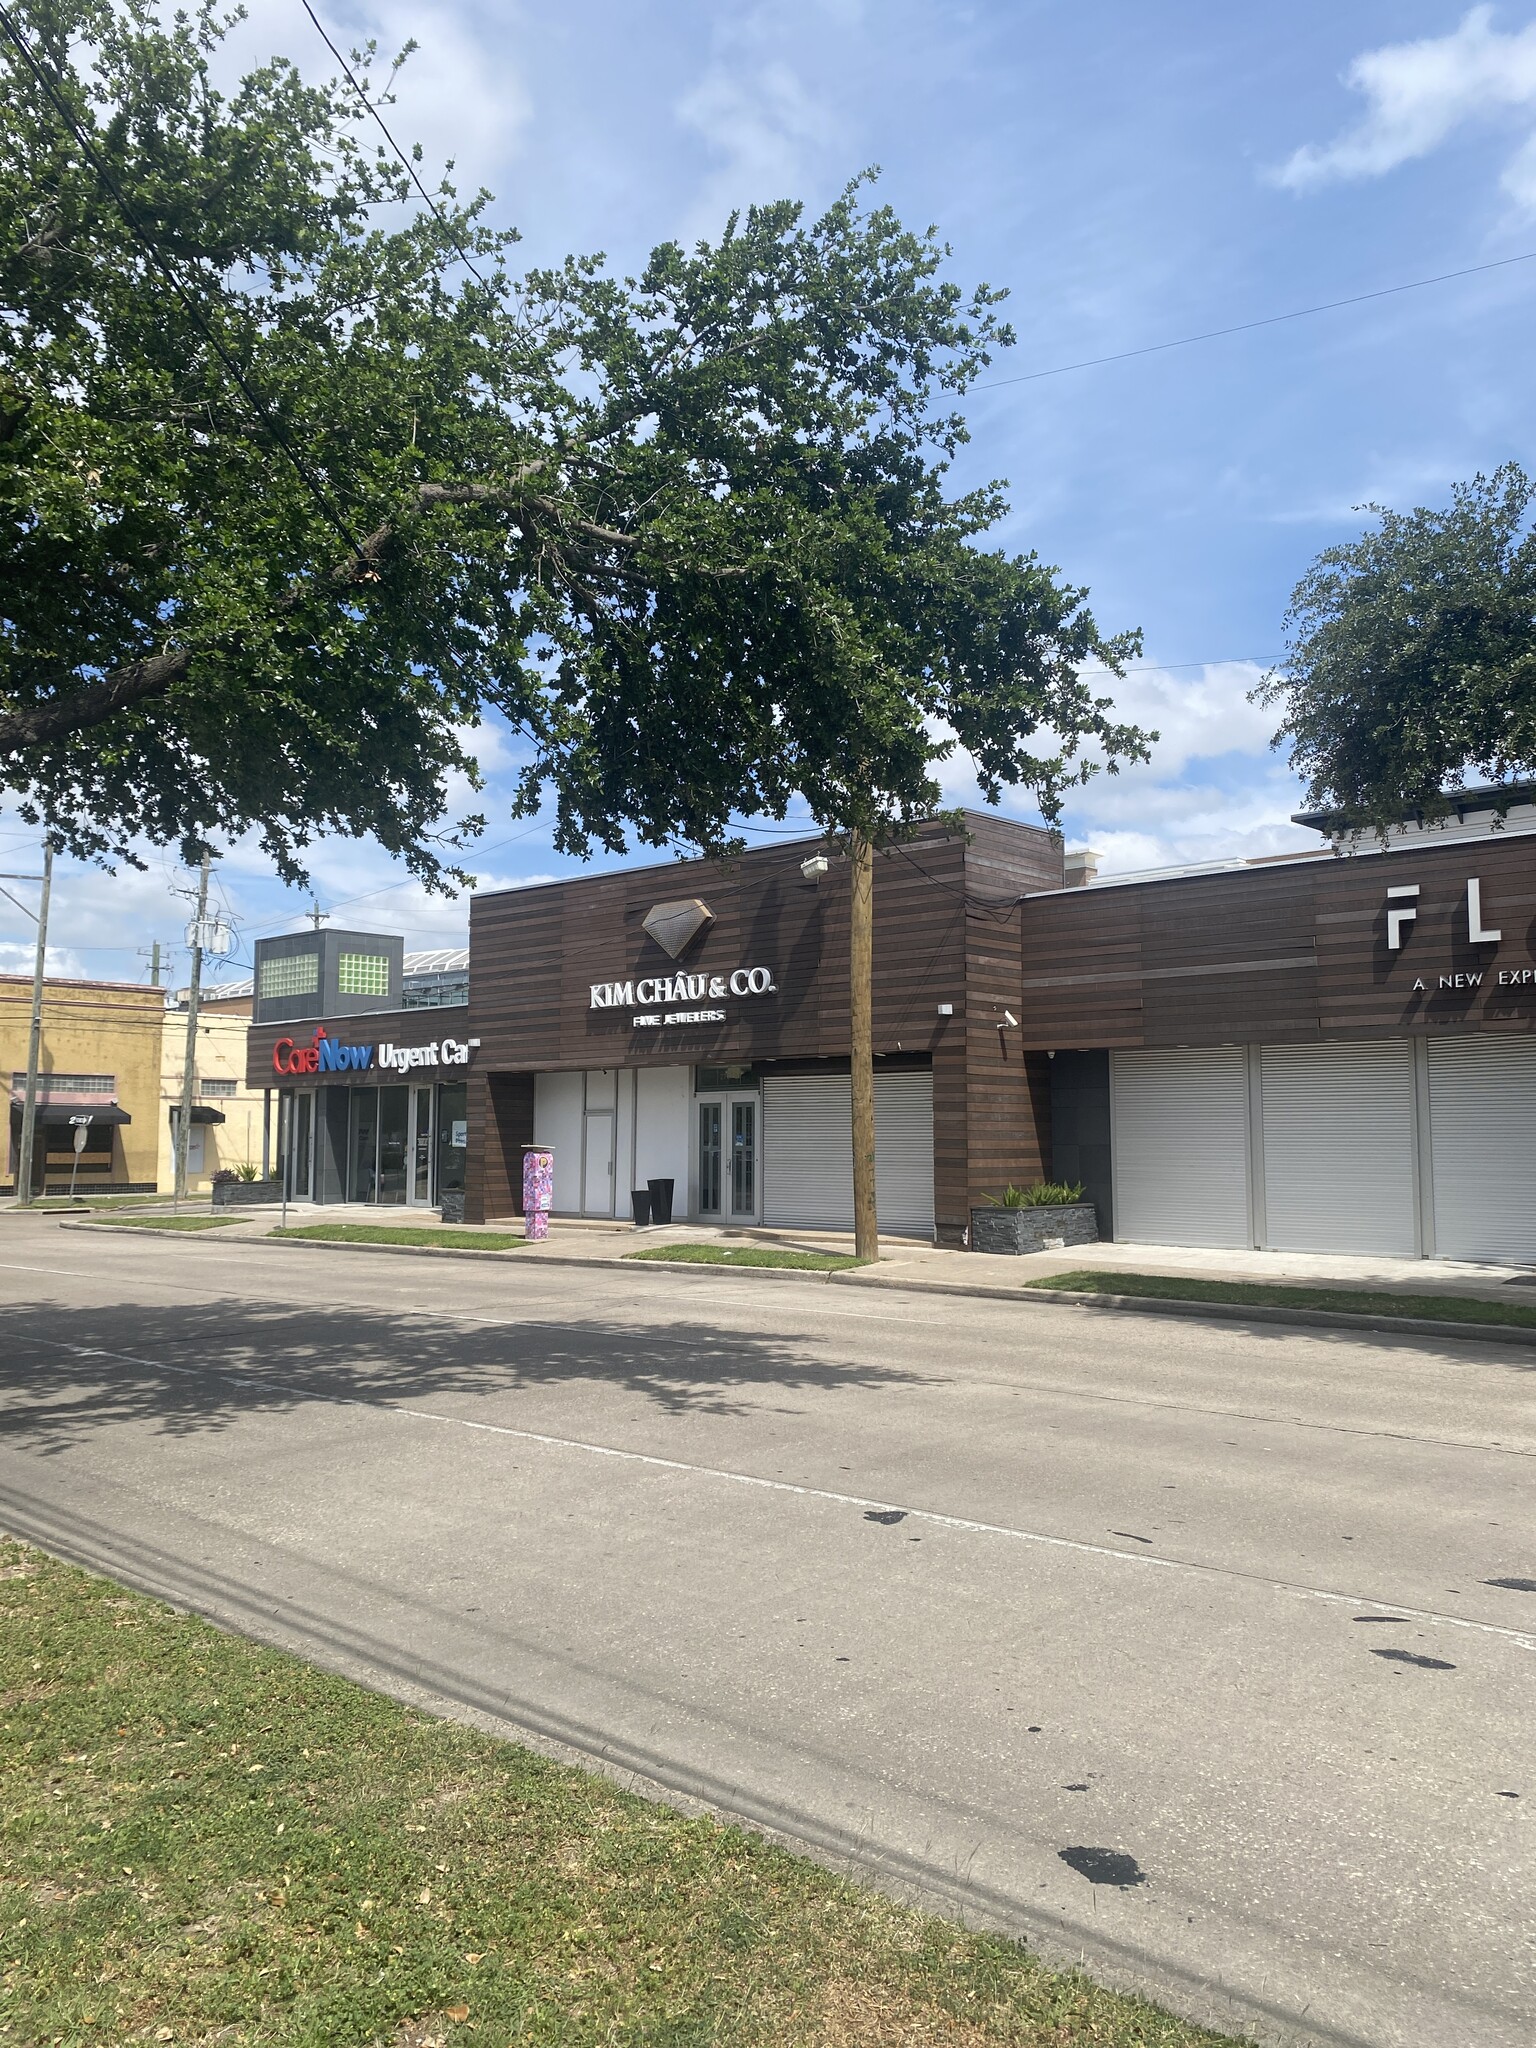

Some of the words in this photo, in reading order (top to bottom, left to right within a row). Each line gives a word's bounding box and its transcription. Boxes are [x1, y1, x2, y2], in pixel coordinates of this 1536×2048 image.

[589, 981, 636, 1009] KIM
[636, 970, 708, 1004] CHÂU
[708, 976, 729, 999] &
[729, 966, 778, 996] CO.
[1412, 976, 1426, 991] A
[1438, 972, 1483, 989] NEW
[272, 1036, 372, 1075] CareNow
[378, 1042, 439, 1074] Urgent
